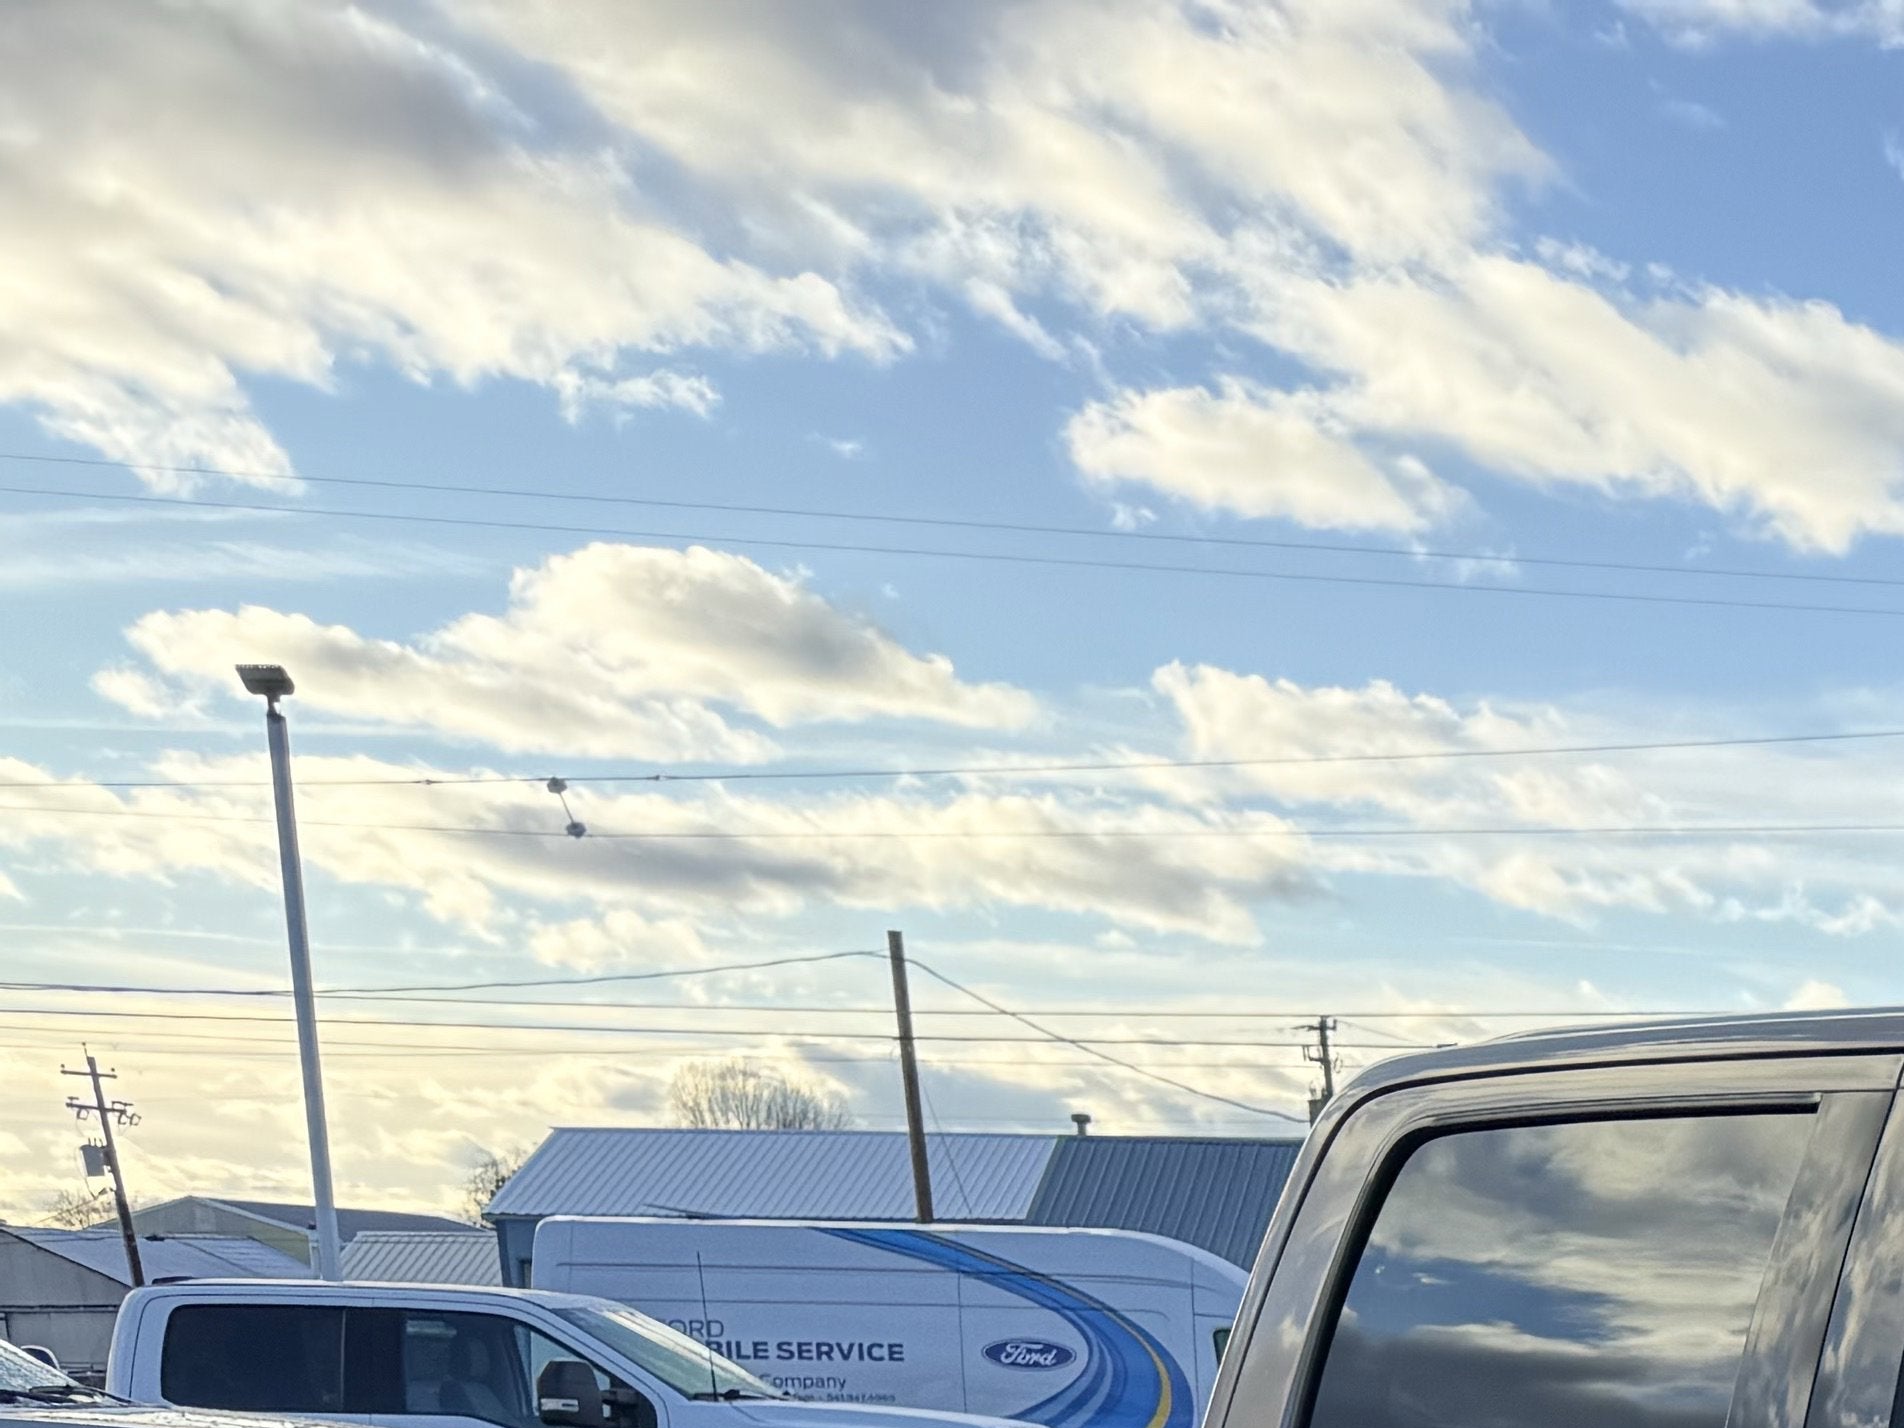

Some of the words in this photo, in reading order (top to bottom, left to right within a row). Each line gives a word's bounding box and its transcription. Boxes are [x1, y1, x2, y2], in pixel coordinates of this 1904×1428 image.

[662, 1318, 725, 1338] ORD
[705, 1340, 770, 1360] BILE
[776, 1341, 905, 1362] SERVICE
[1001, 1343, 1058, 1366] Ford
